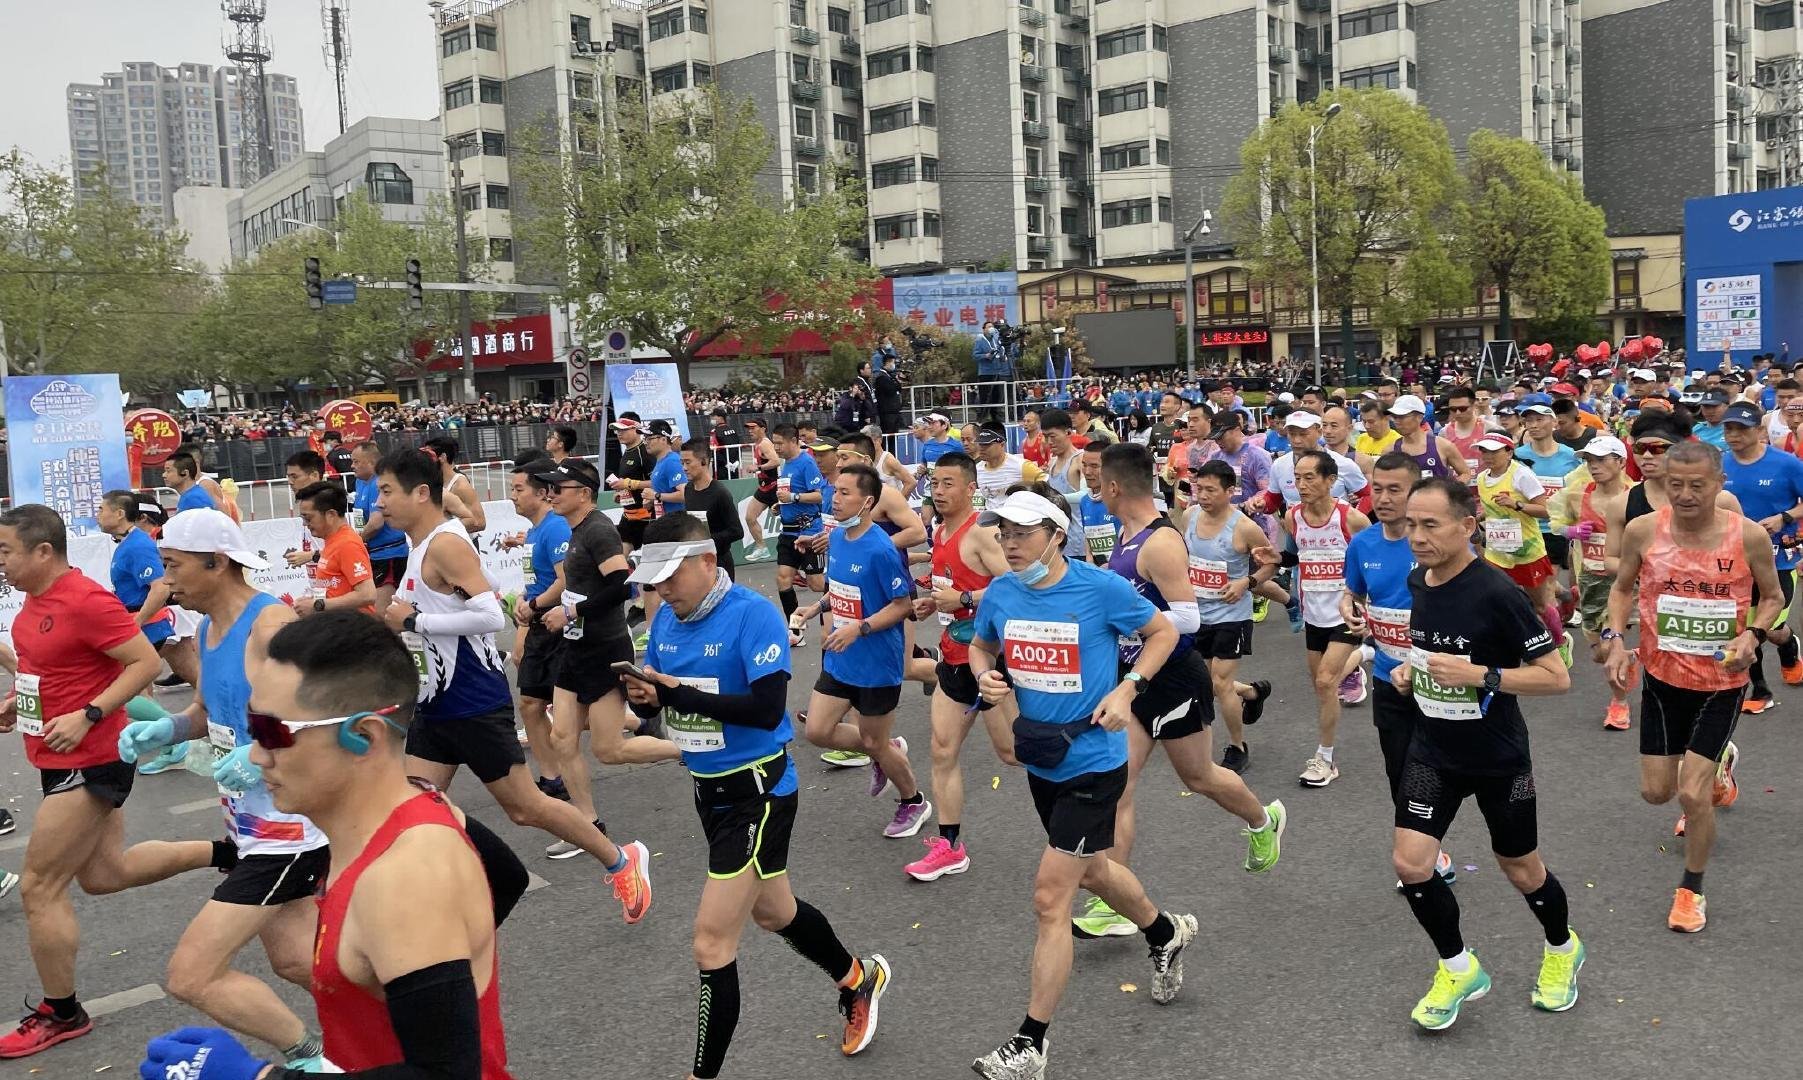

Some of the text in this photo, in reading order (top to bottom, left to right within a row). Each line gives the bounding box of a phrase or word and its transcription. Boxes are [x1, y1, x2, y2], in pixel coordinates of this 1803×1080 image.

[908, 304, 1007, 327] 专业电瓶
[330, 410, 367, 429] 徐工
[132, 420, 175, 443] 奔跑
[1090, 537, 1115, 549] A1918
[253, 575, 275, 584] COAL
[278, 572, 306, 582] MINING
[1189, 569, 1222, 585] A1128
[1305, 564, 1343, 575] A0505
[1663, 578, 1731, 597] 太合集团
[1664, 616, 1730, 635] A1560
[1011, 644, 1070, 666] A0021
